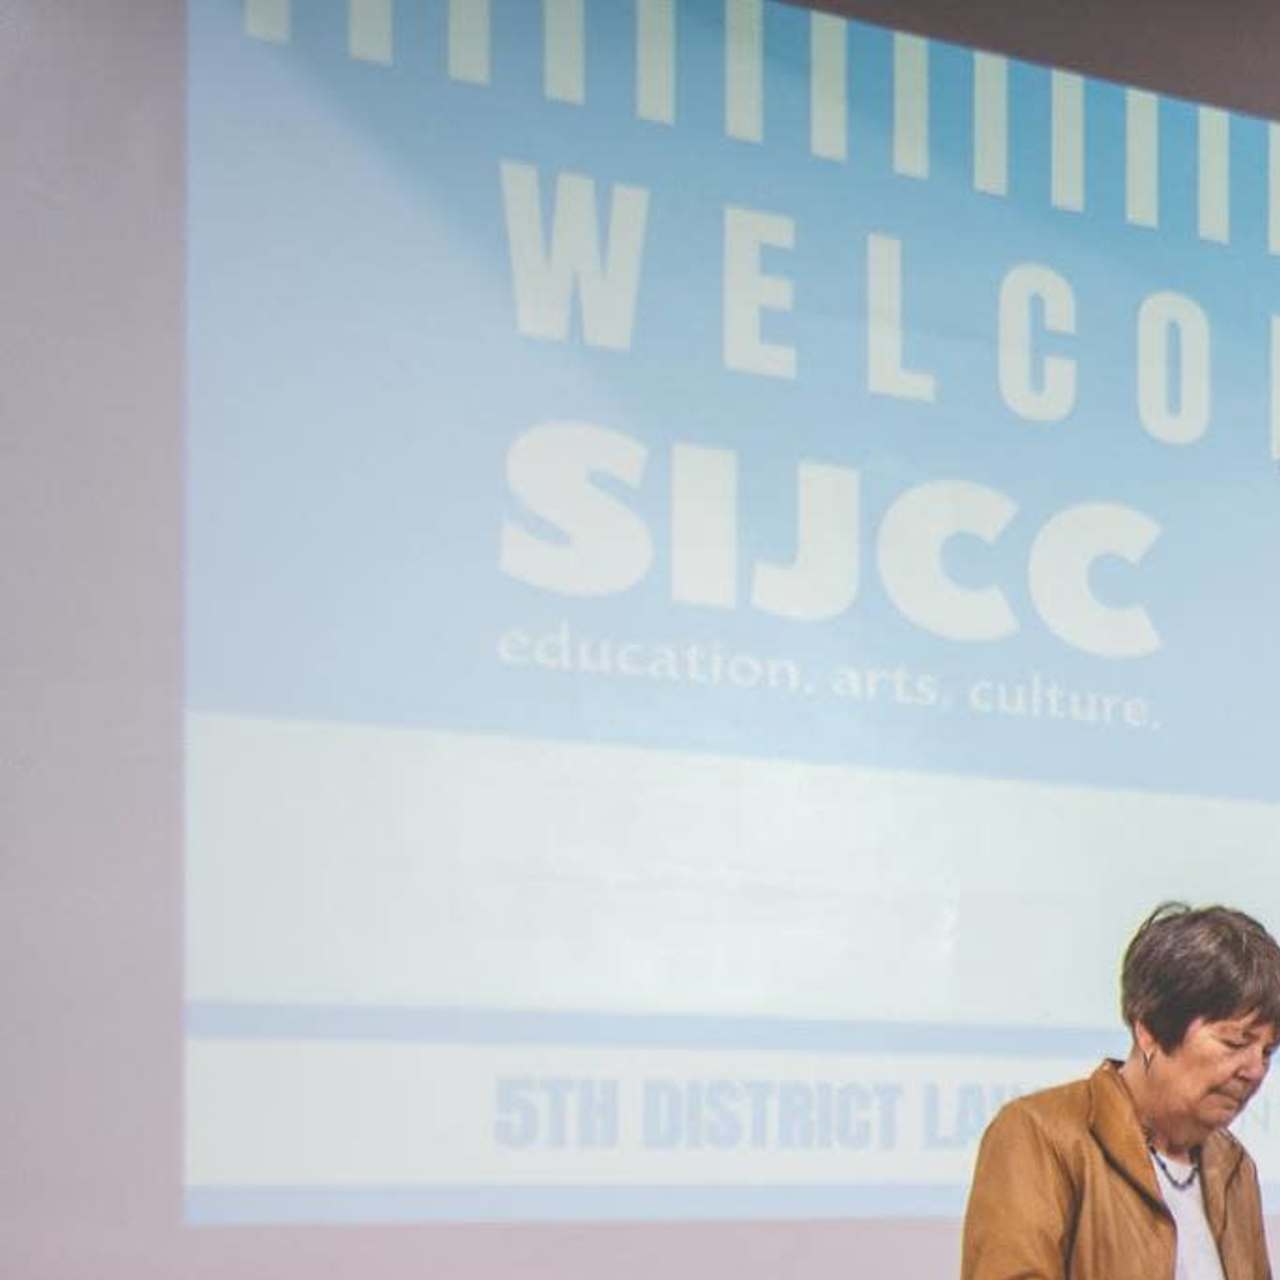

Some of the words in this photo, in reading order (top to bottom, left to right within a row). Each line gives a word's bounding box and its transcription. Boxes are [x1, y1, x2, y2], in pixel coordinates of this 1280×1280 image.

[498, 418, 1164, 660] SIJCC
[496, 620, 815, 695] education.
[967, 671, 1162, 731] culture.
[492, 1077, 620, 1151] 5TH
[640, 1079, 904, 1152] DISTRICT
